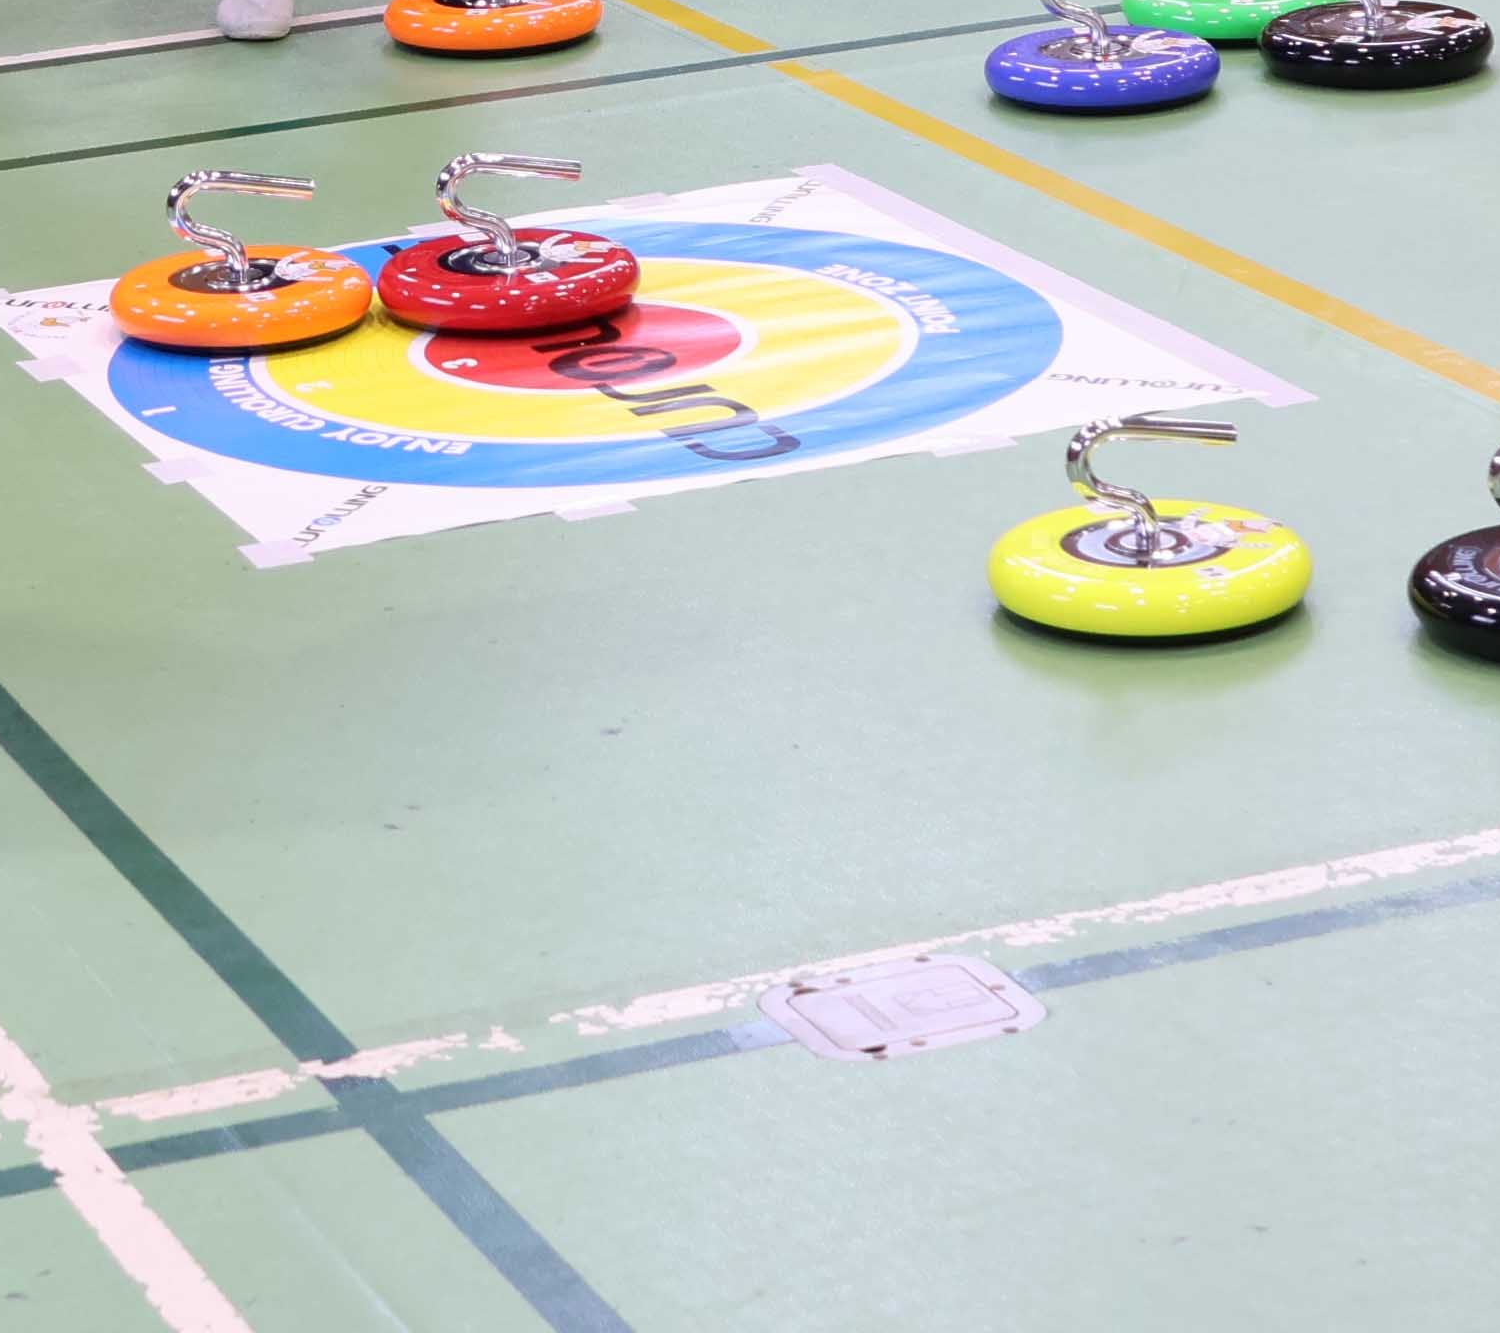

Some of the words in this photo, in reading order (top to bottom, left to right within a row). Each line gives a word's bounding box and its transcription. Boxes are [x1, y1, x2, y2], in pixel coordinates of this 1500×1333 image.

[813, 263, 919, 296] ZONE
[440, 357, 478, 370] 3
[208, 363, 326, 432] CUROLLING
[320, 428, 468, 455] ENJOY
